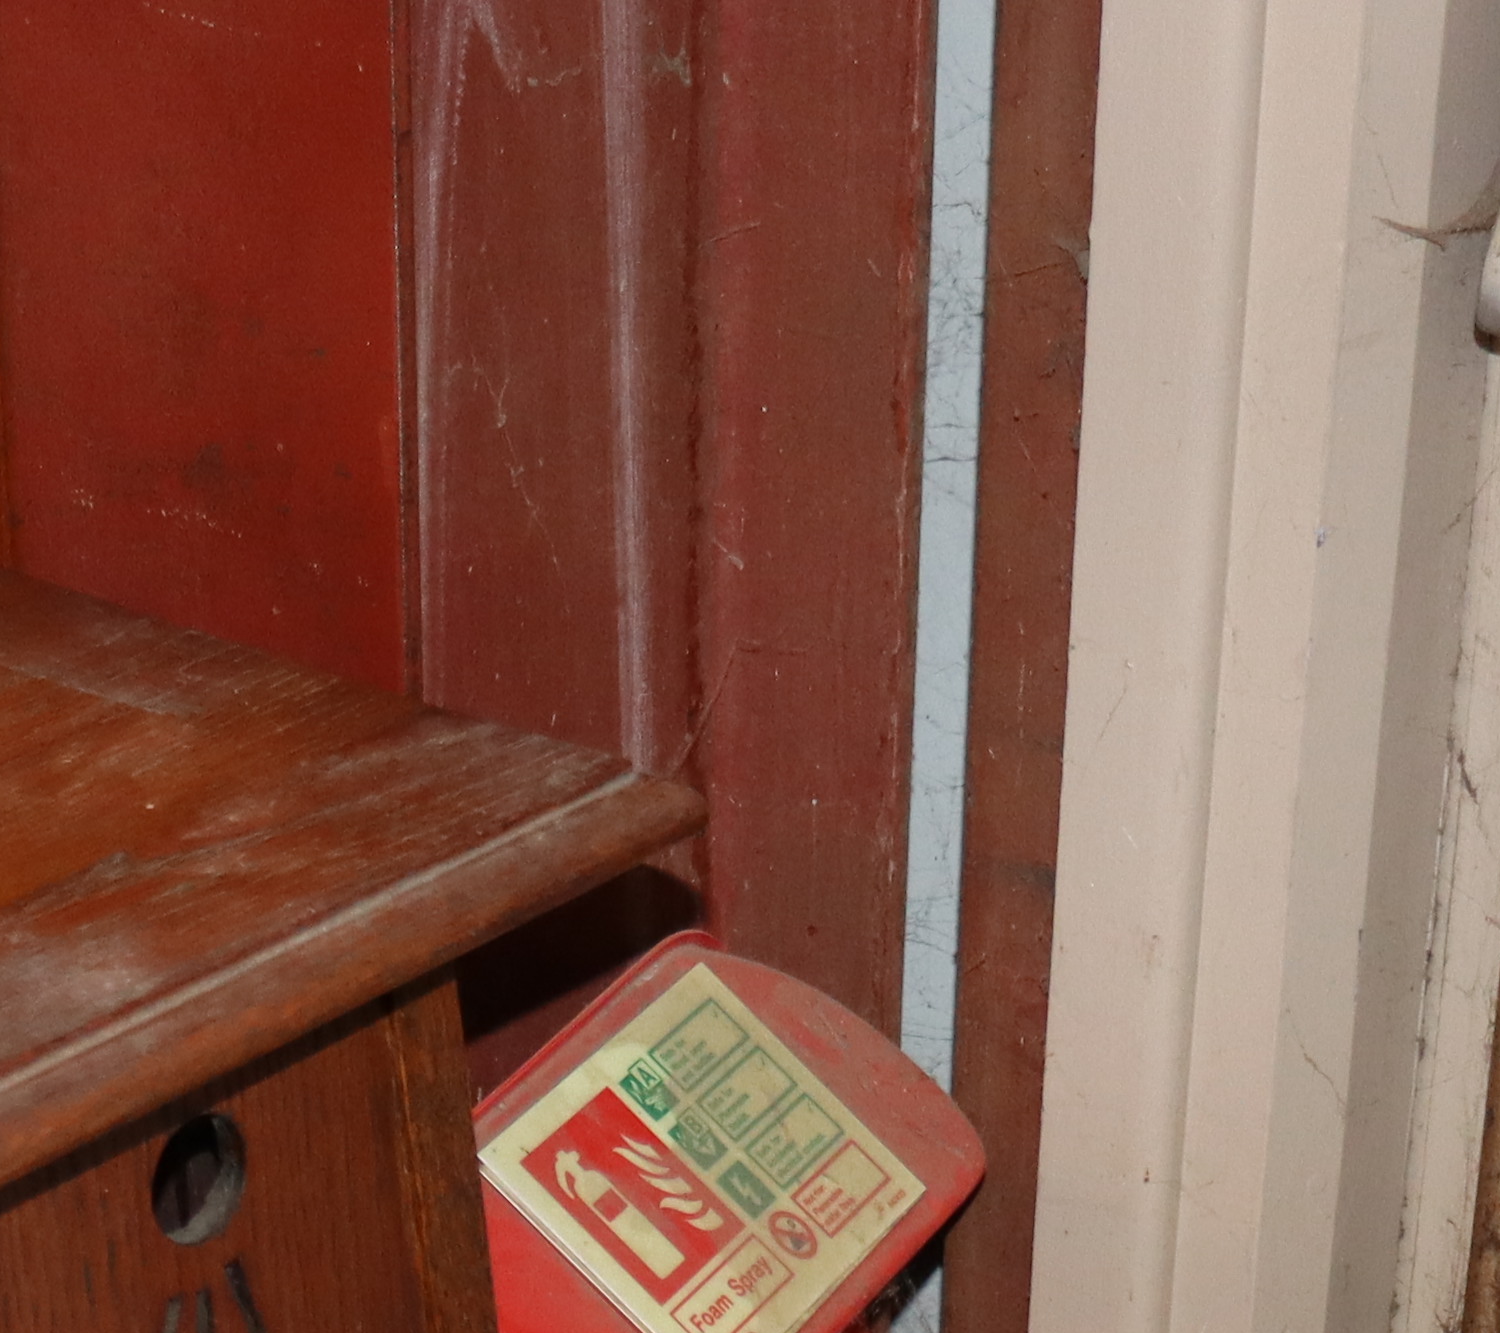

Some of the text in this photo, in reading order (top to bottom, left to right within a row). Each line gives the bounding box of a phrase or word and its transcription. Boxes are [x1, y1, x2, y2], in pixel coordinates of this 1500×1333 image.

[636, 1066, 659, 1088] A
[689, 1256, 774, 1333] Foam Spray
